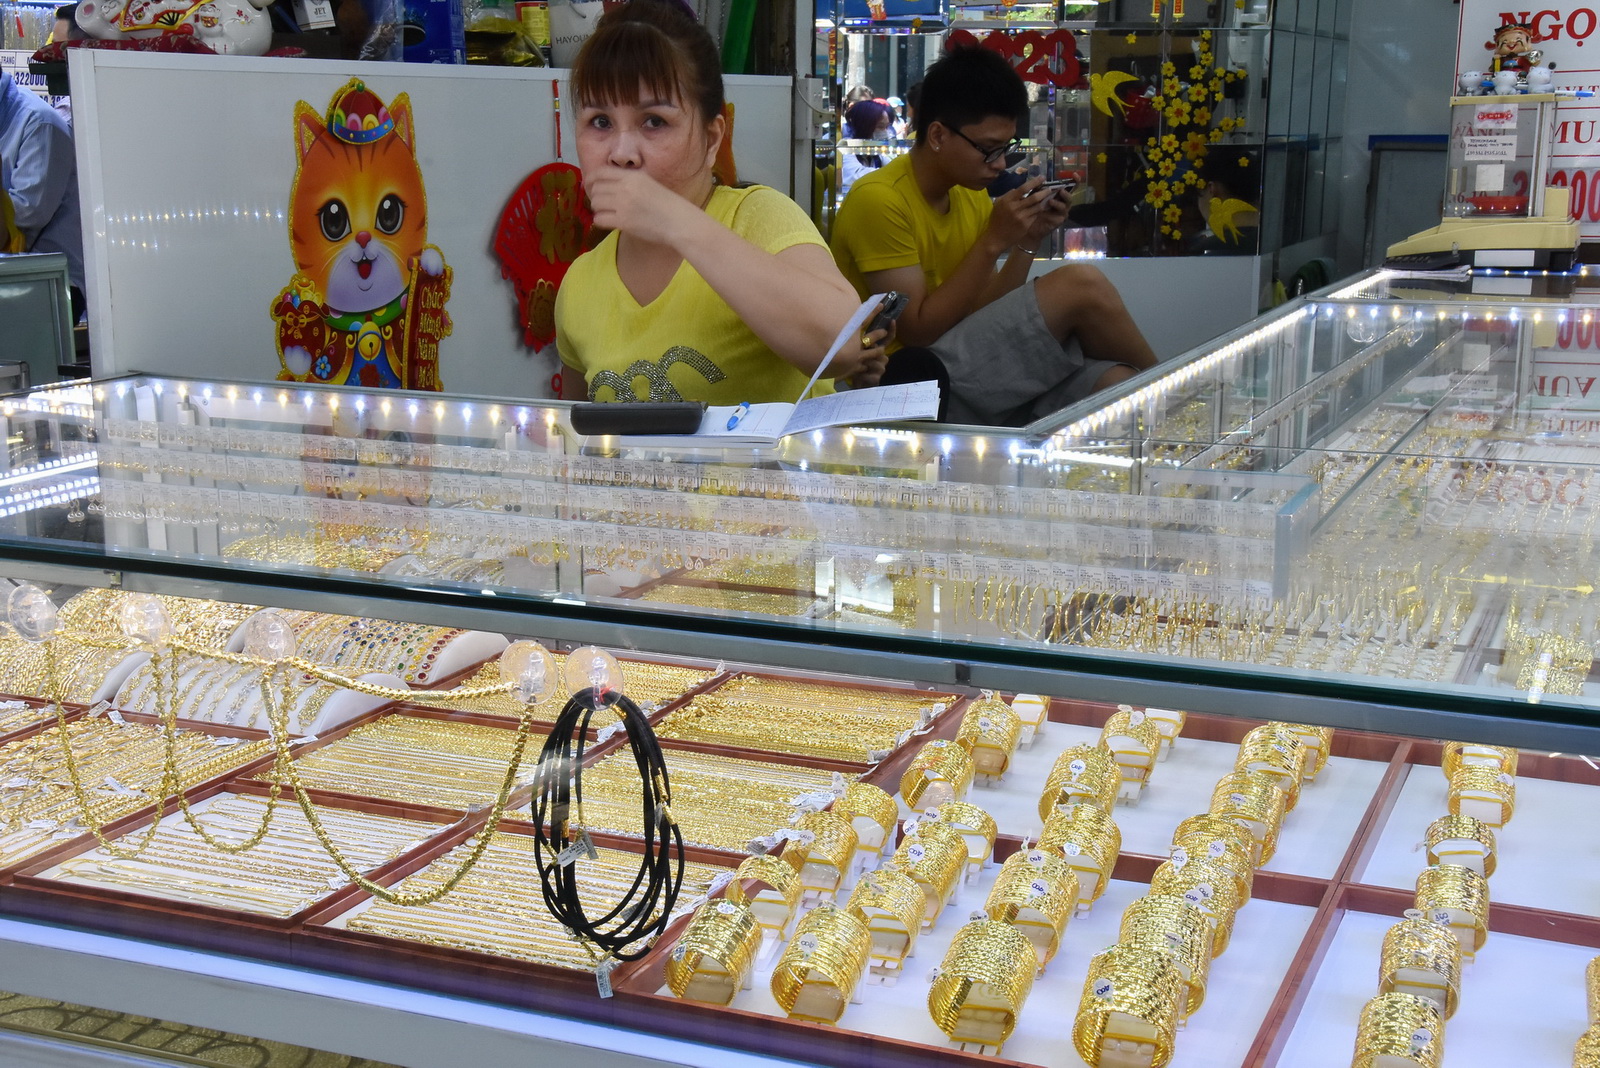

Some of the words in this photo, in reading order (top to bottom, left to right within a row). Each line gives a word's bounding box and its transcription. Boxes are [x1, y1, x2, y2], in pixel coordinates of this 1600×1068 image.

[314, 7, 327, 15] JET
[1550, 120, 1600, 143] MU
[421, 284, 443, 309] Chúc
